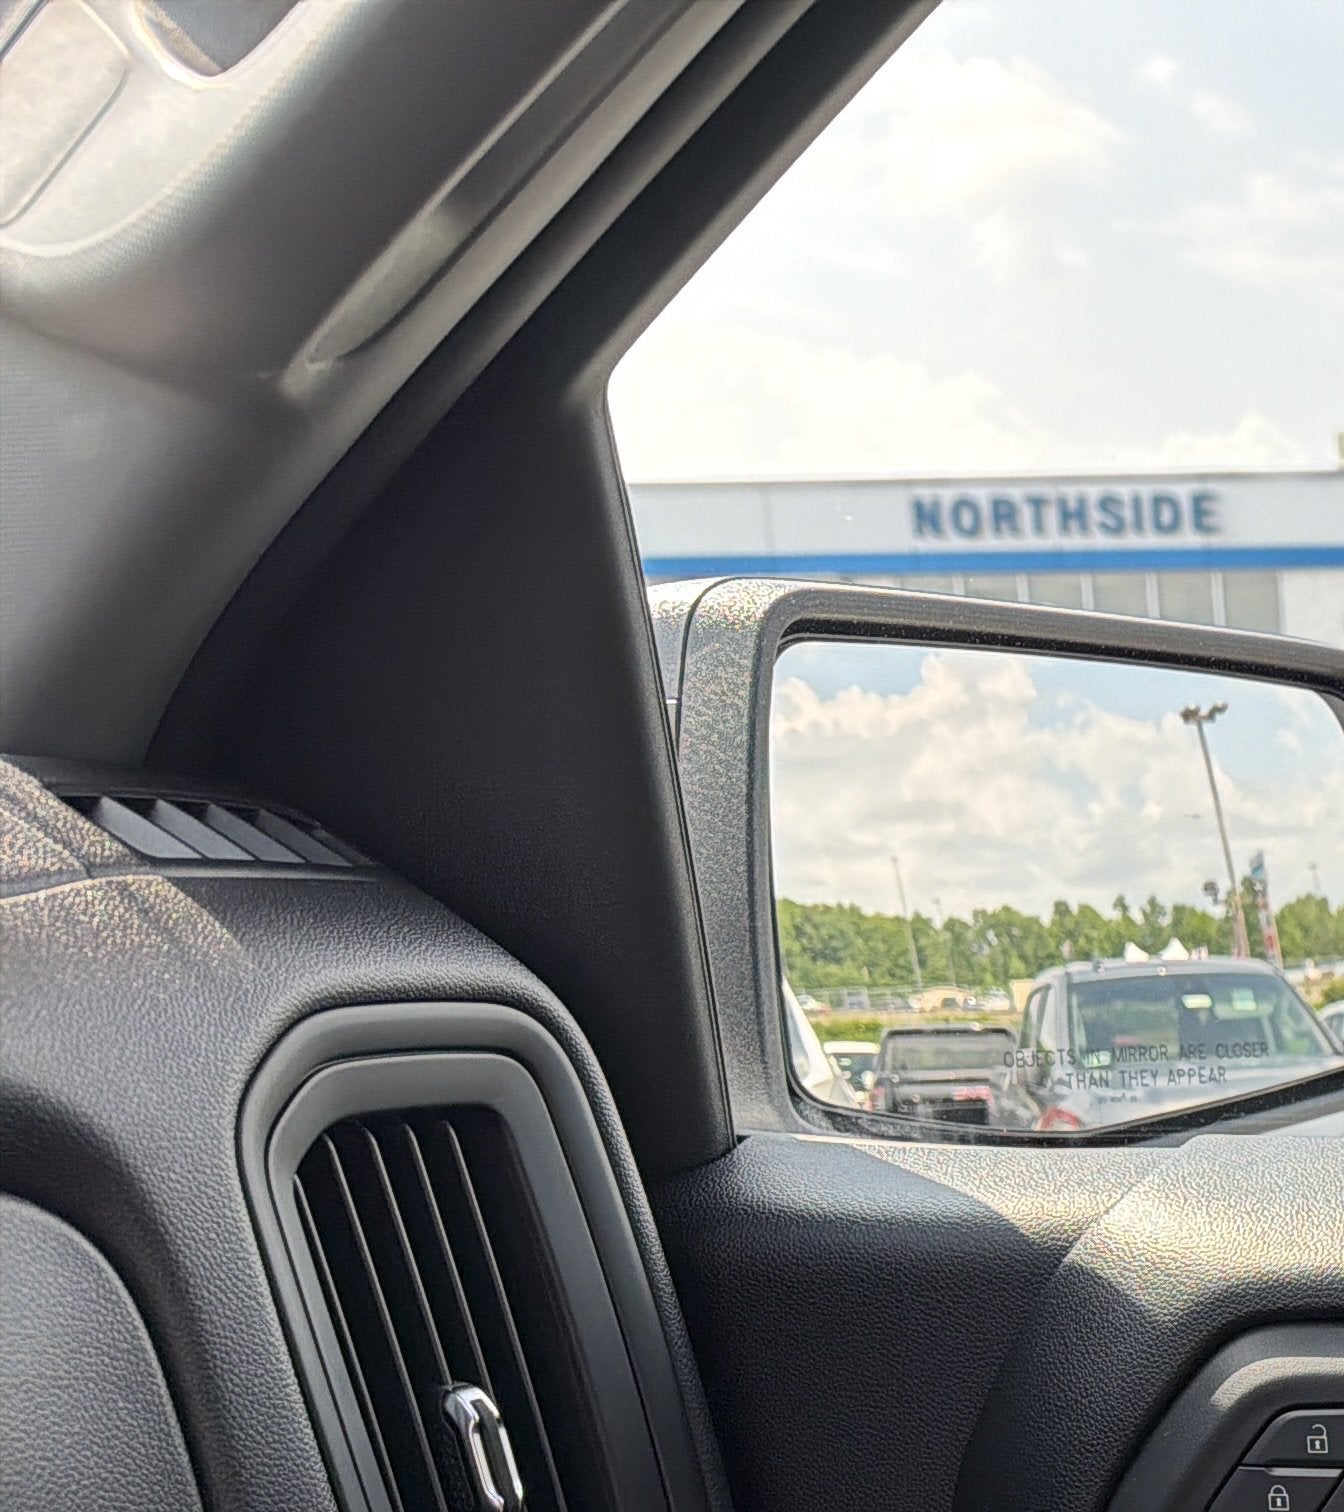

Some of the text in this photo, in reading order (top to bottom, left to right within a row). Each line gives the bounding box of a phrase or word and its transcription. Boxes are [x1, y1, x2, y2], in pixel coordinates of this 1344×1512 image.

[912, 488, 1220, 538] NORTHSIDE
[1003, 1047, 1076, 1069] OBJECTS
[1111, 1043, 1169, 1064] MIRROR
[1179, 1042, 1207, 1060] ARE
[1216, 1041, 1270, 1060] CLOSER
[1066, 1066, 1228, 1090] THAN THEY APPEAR
